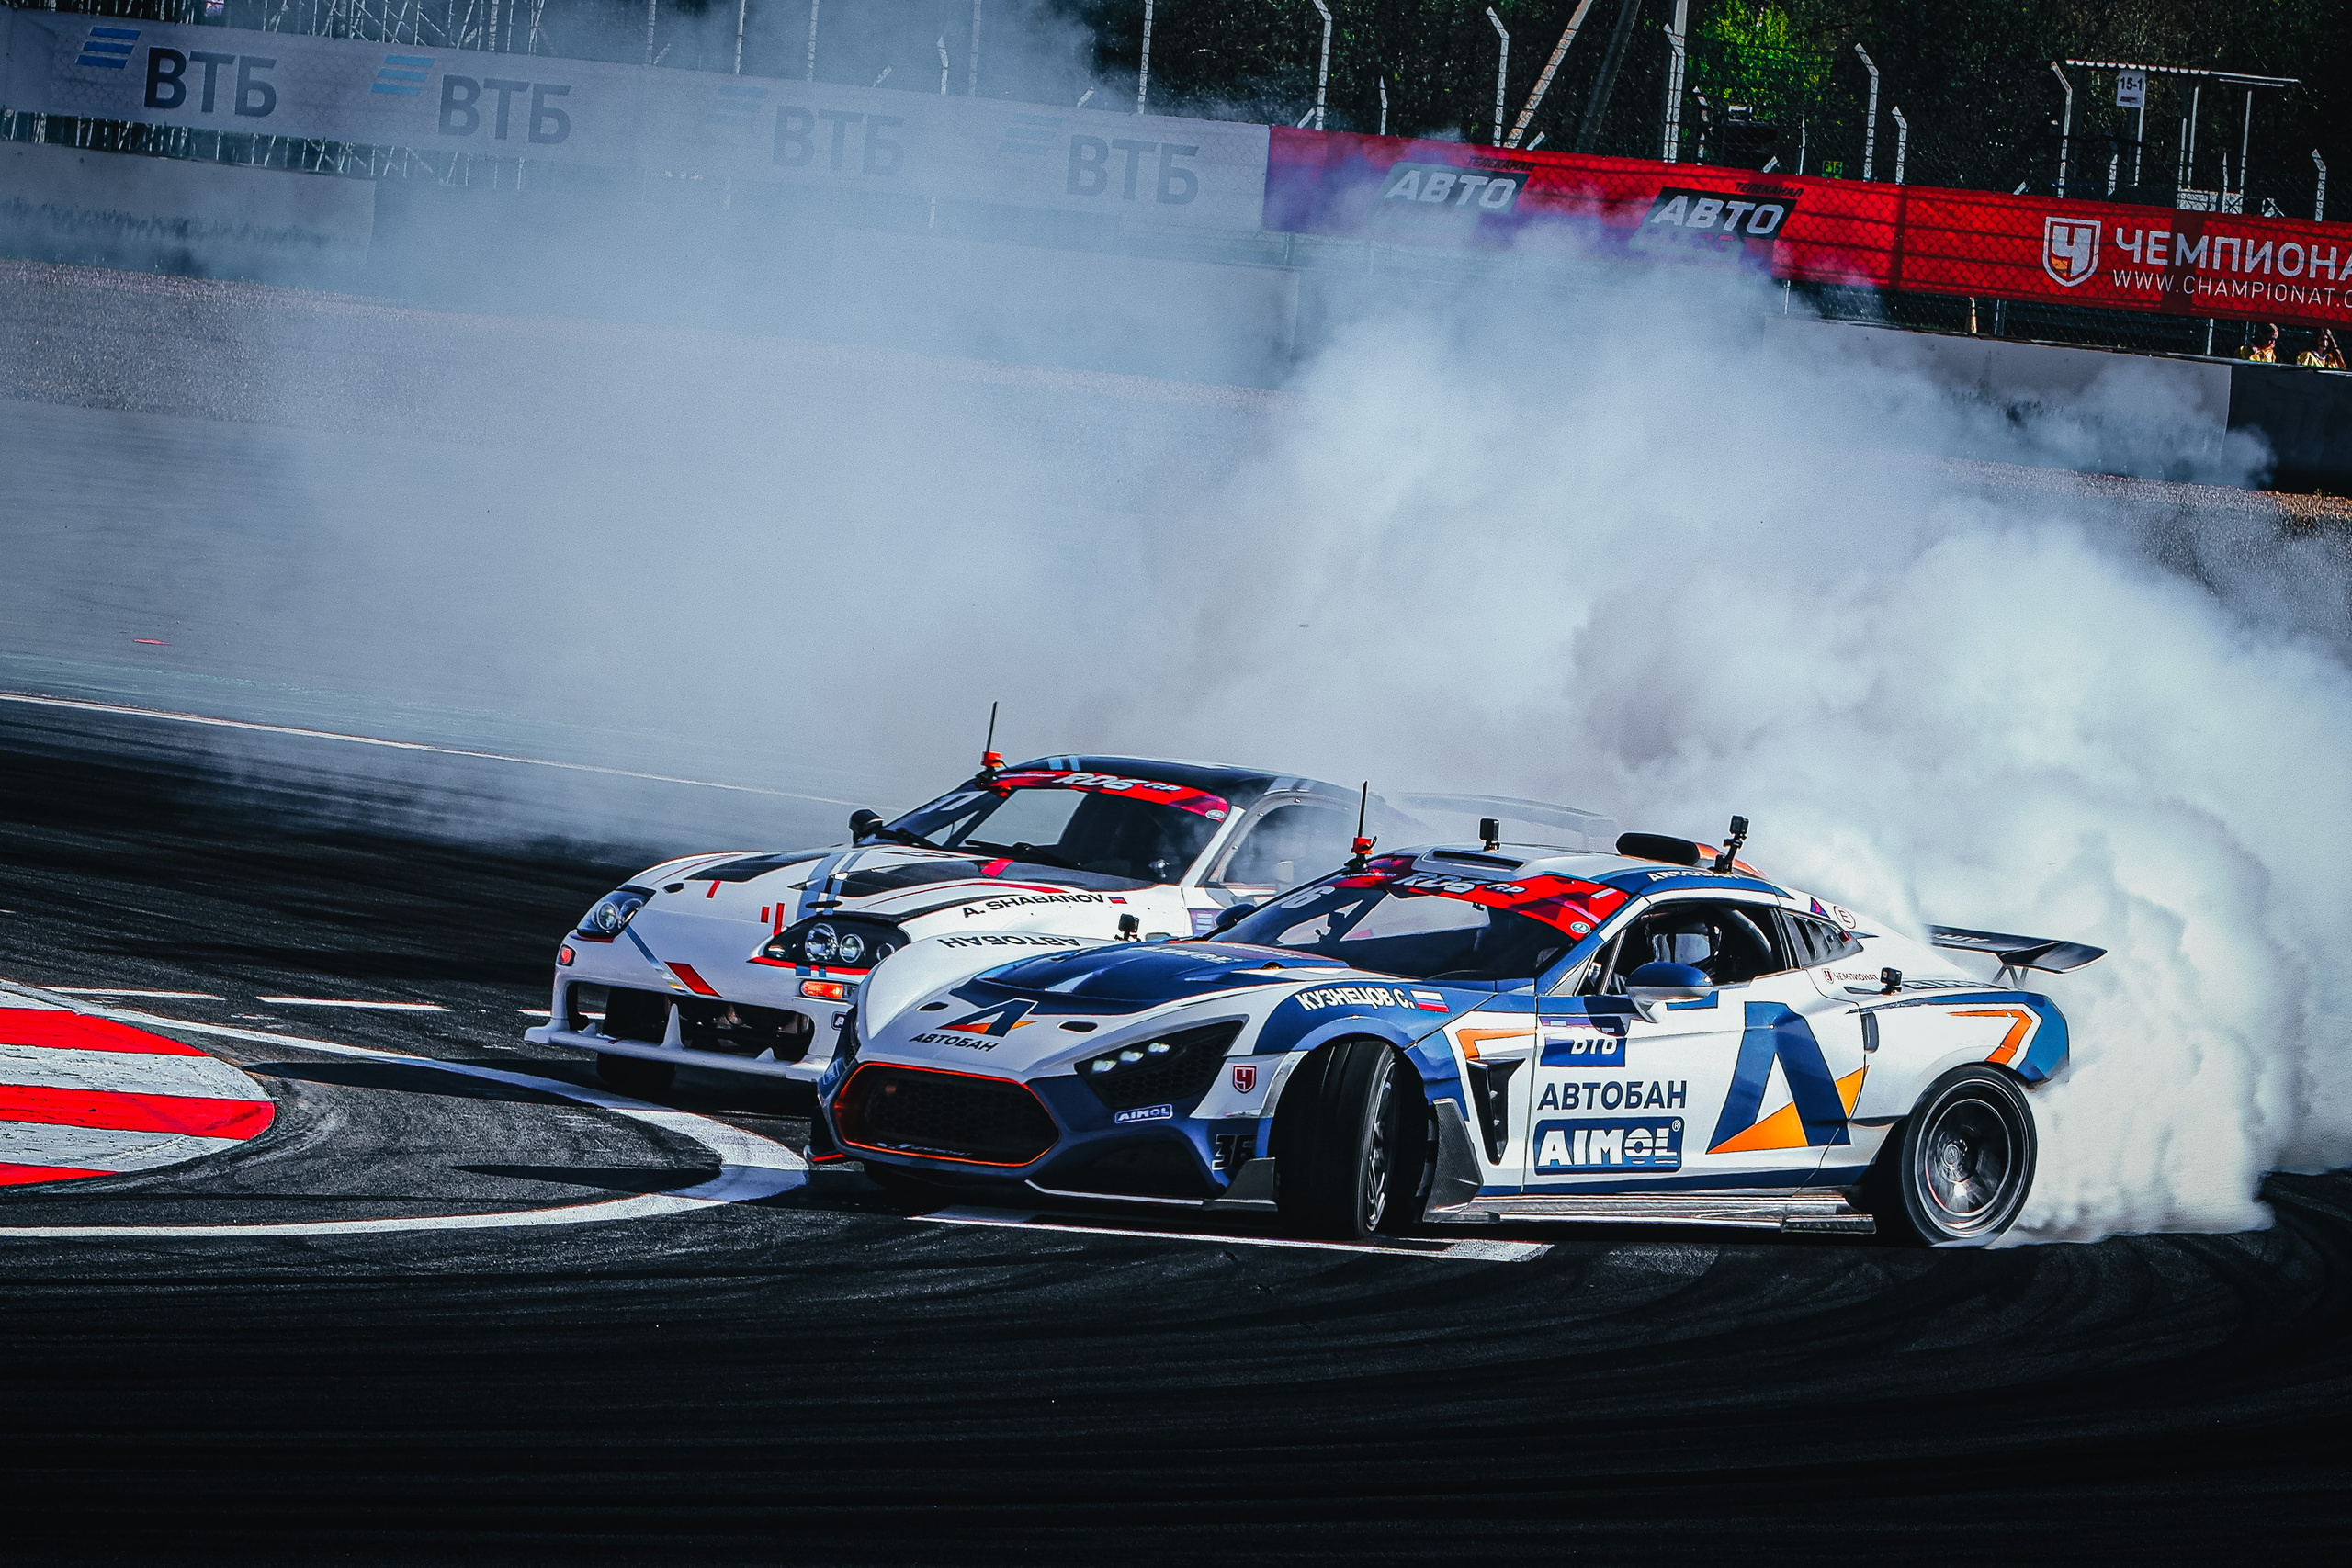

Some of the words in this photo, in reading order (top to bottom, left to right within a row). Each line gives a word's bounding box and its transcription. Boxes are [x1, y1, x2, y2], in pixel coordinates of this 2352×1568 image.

[143, 47, 277, 118] ВТБ
[2120, 76, 2143, 91] 15-1
[438, 74, 571, 144] ВТБ
[771, 105, 905, 176] ВТБ
[1066, 134, 1200, 205] ВТБ
[1385, 169, 1519, 209] АВТО
[1735, 181, 1804, 197] ТЕЛЕКАНАЛ
[1650, 195, 1785, 234] АВТО
[1052, 773, 1147, 791] RDS
[1392, 872, 1490, 894] RDS
[962, 906, 986, 918] A.
[989, 893, 1107, 910] SHABANOV
[1833, 972, 1879, 981] ЧЕМПИОНАТ
[1295, 987, 1393, 1011] КУЗНЕЦОВ
[909, 1032, 999, 1052] АВТОБАН
[1537, 1080, 1687, 1111] АВТОБАН
[1118, 1108, 1169, 1121] AIMOL
